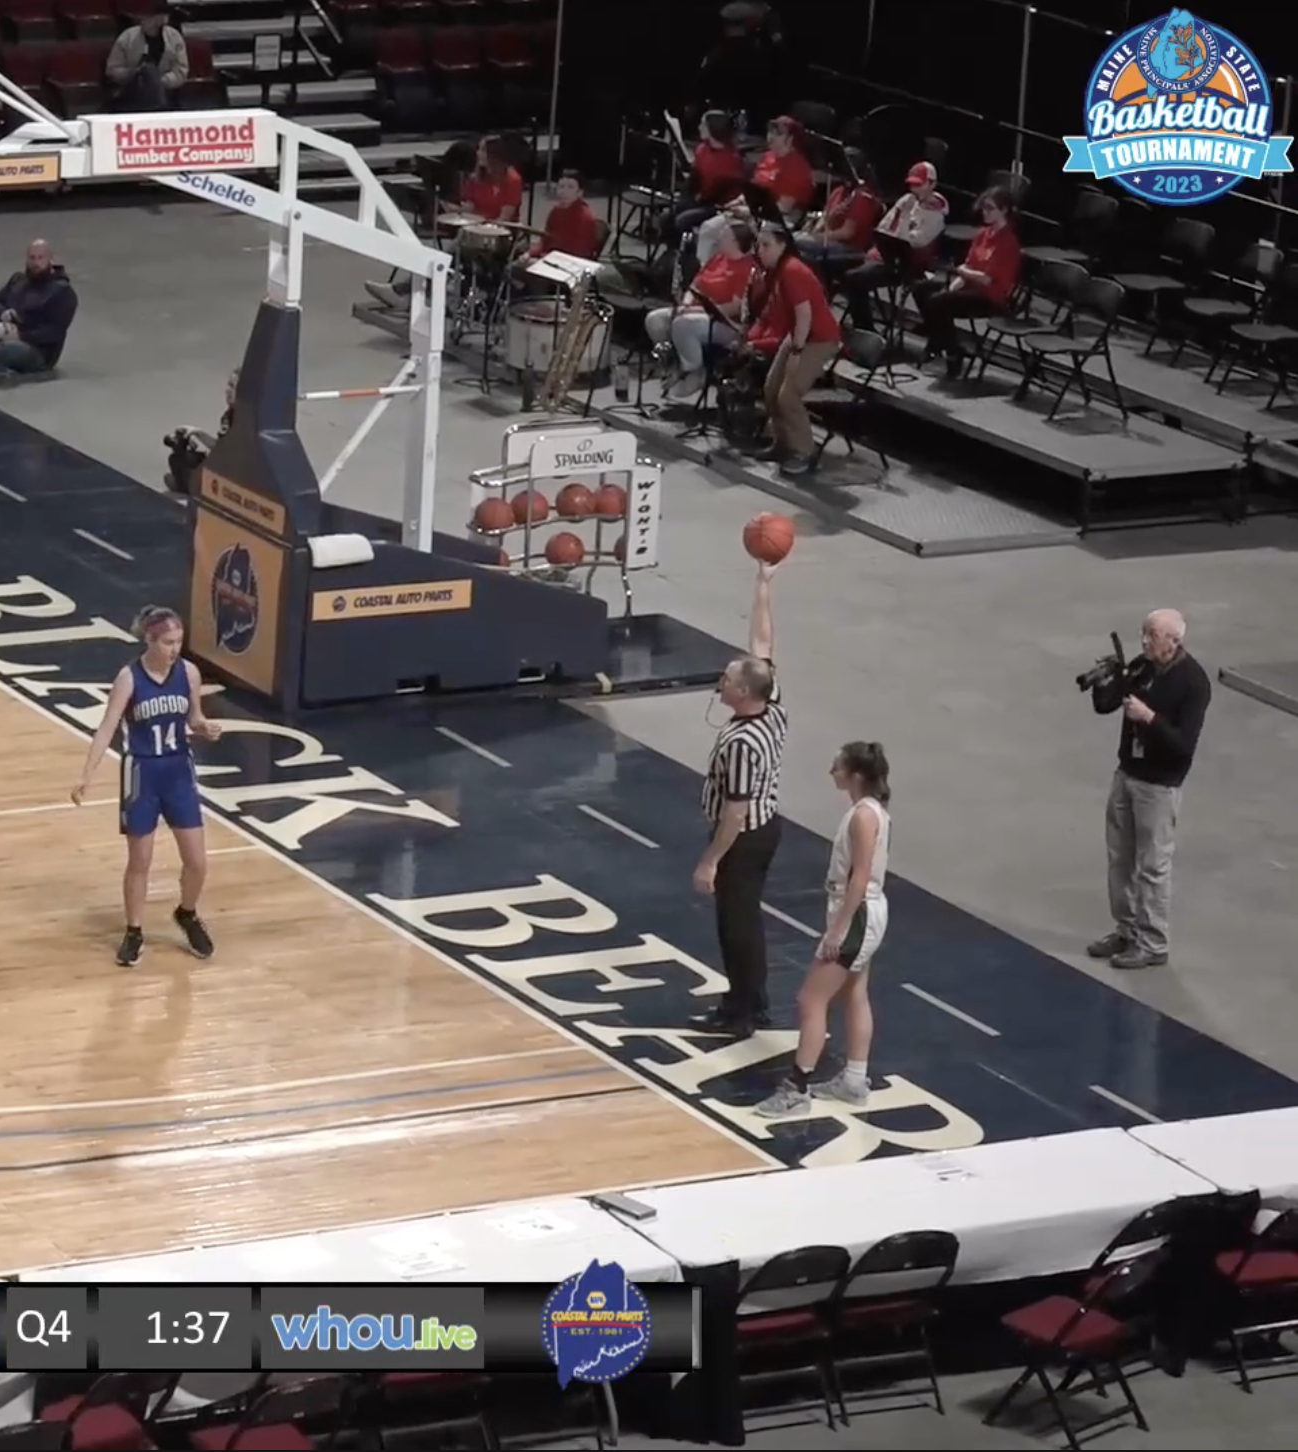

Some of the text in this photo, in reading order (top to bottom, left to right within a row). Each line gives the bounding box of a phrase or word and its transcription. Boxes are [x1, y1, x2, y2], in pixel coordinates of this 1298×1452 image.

[115, 117, 255, 146] Hammond
[118, 145, 253, 165] Lumber Company
[177, 171, 256, 207] Schelde
[554, 449, 614, 469] SPALDING
[353, 588, 454, 609] COASTAL AUTO PARTS
[151, 721, 178, 756] 14
[366, 873, 985, 1168] BEAR
